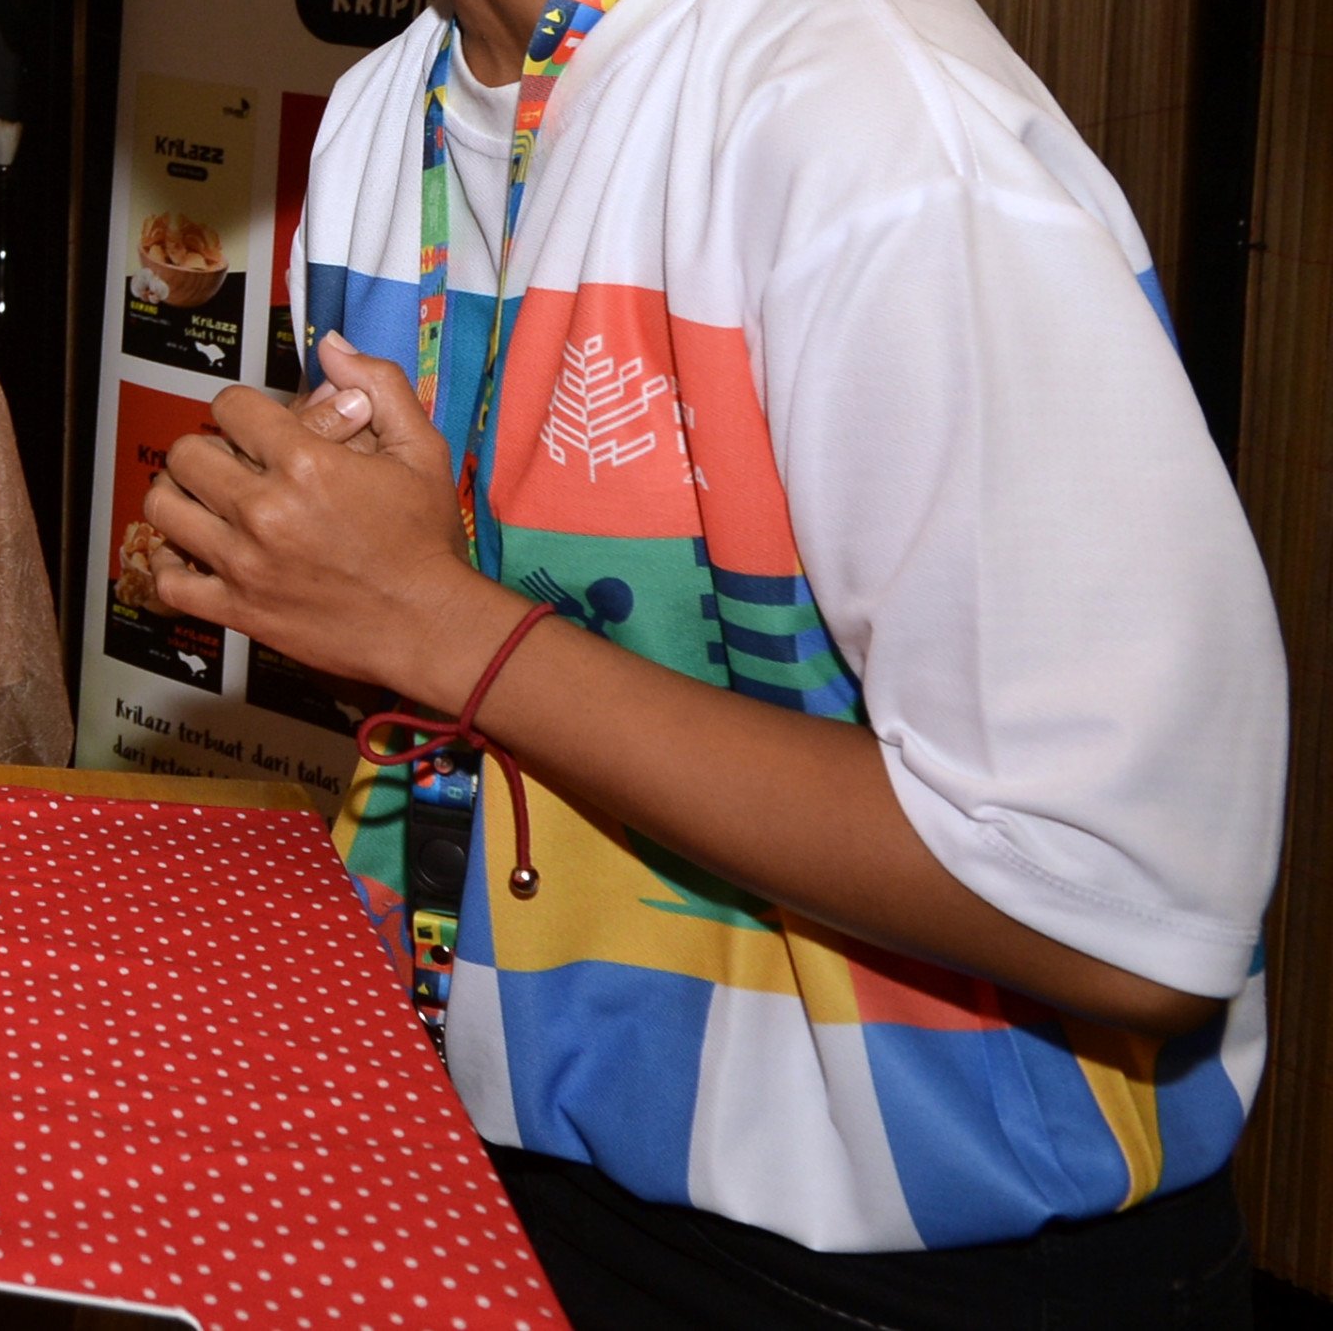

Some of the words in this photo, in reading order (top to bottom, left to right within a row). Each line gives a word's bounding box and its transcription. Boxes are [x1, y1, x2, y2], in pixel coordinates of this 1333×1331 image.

[112, 735, 145, 766] dari
[177, 722, 243, 763] terbuat
[251, 743, 290, 777] dari
[297, 760, 341, 796] talas
